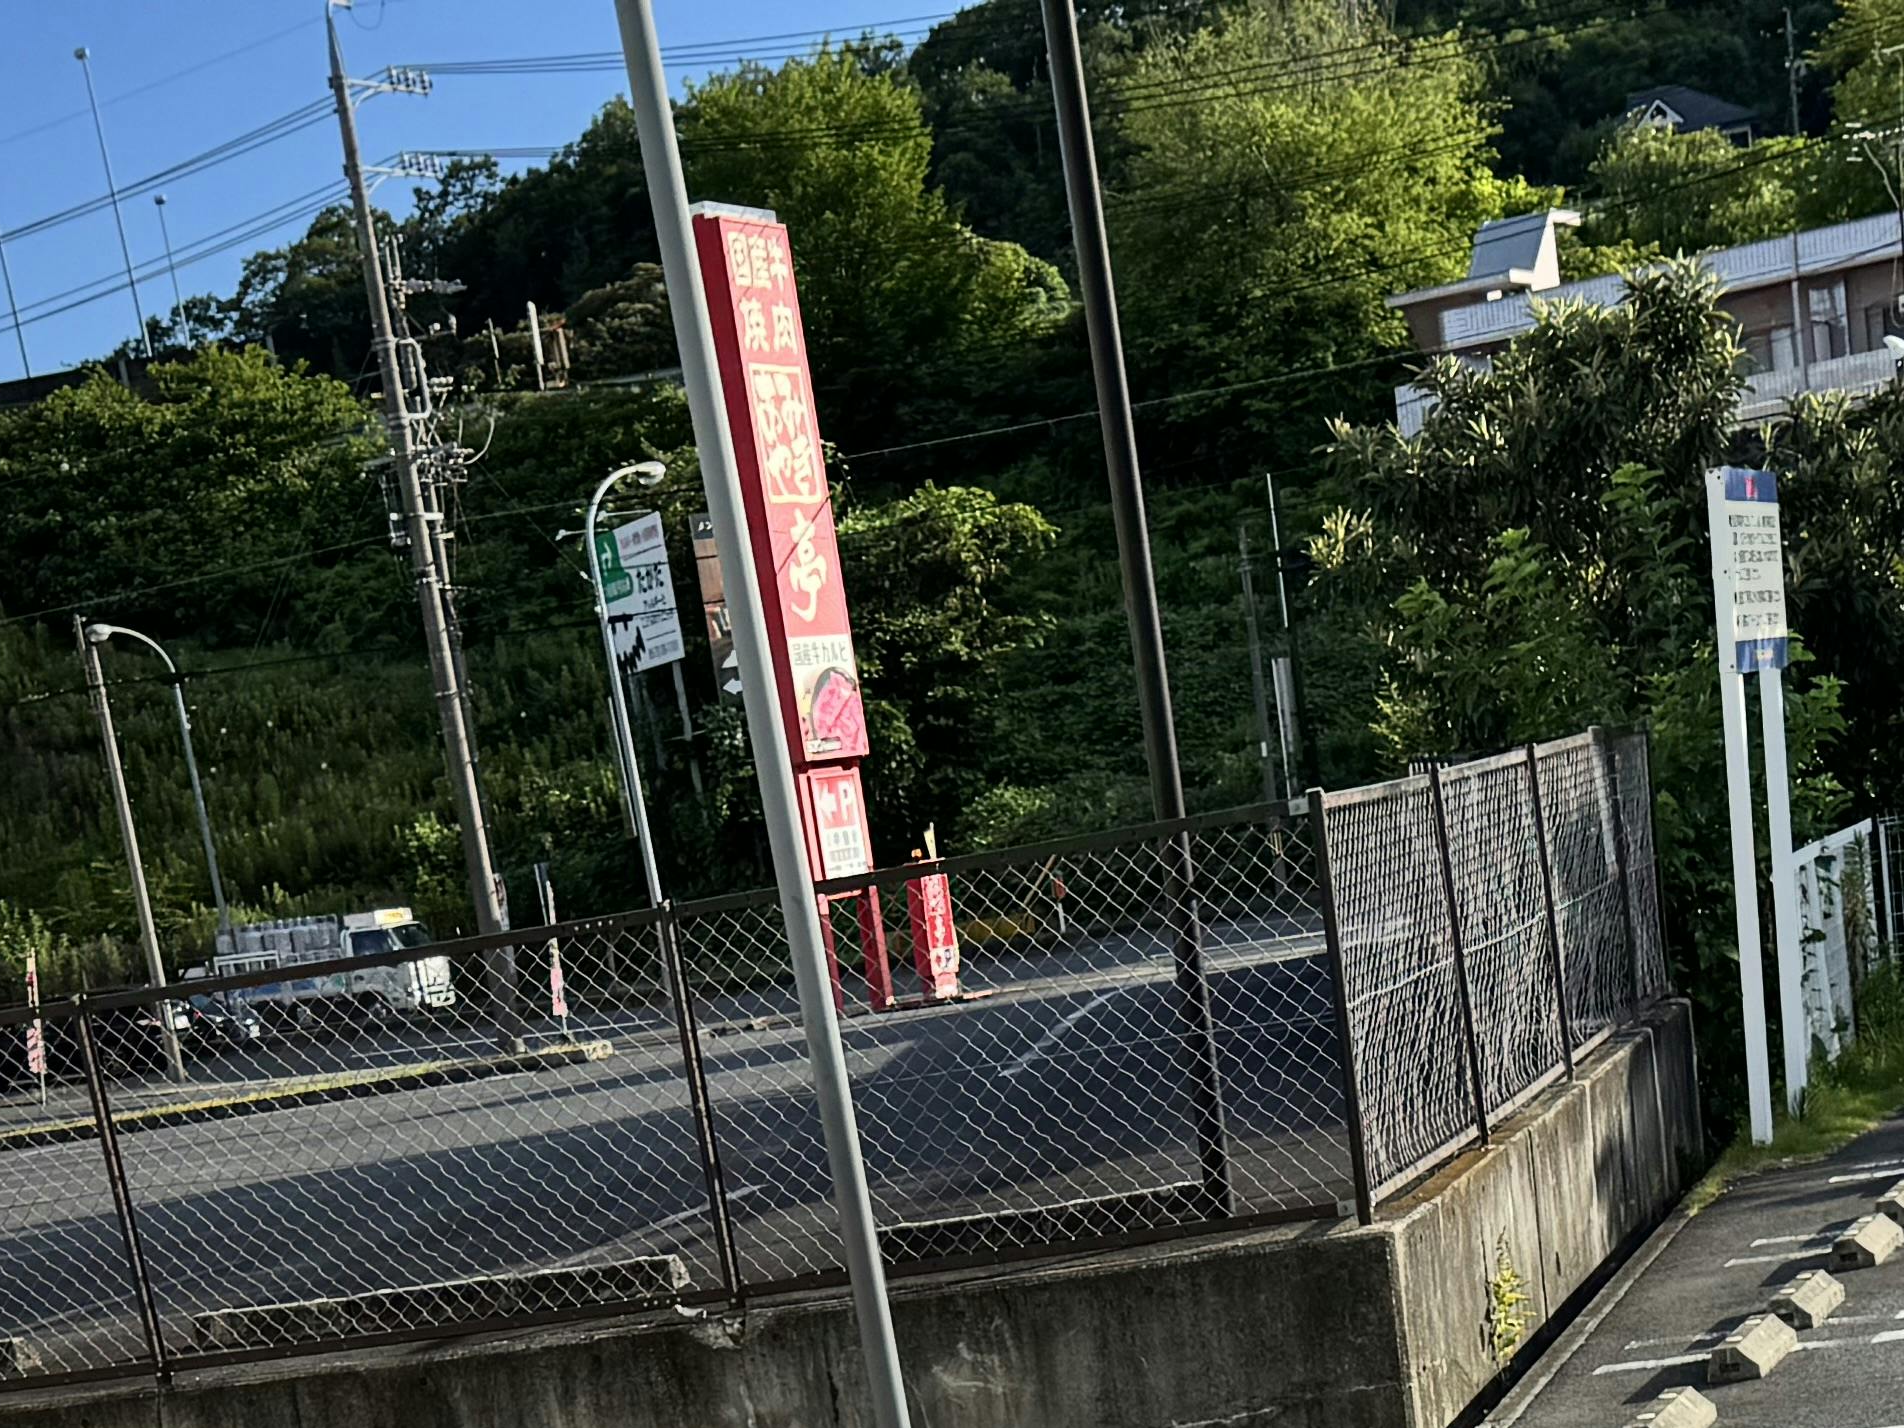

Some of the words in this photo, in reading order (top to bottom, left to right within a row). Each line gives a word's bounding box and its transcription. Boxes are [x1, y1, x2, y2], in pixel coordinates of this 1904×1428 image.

[728, 233, 788, 289] 国産牛
[740, 300, 798, 356] 焼肉
[754, 372, 818, 497] あみやき
[788, 508, 827, 622] 亭
